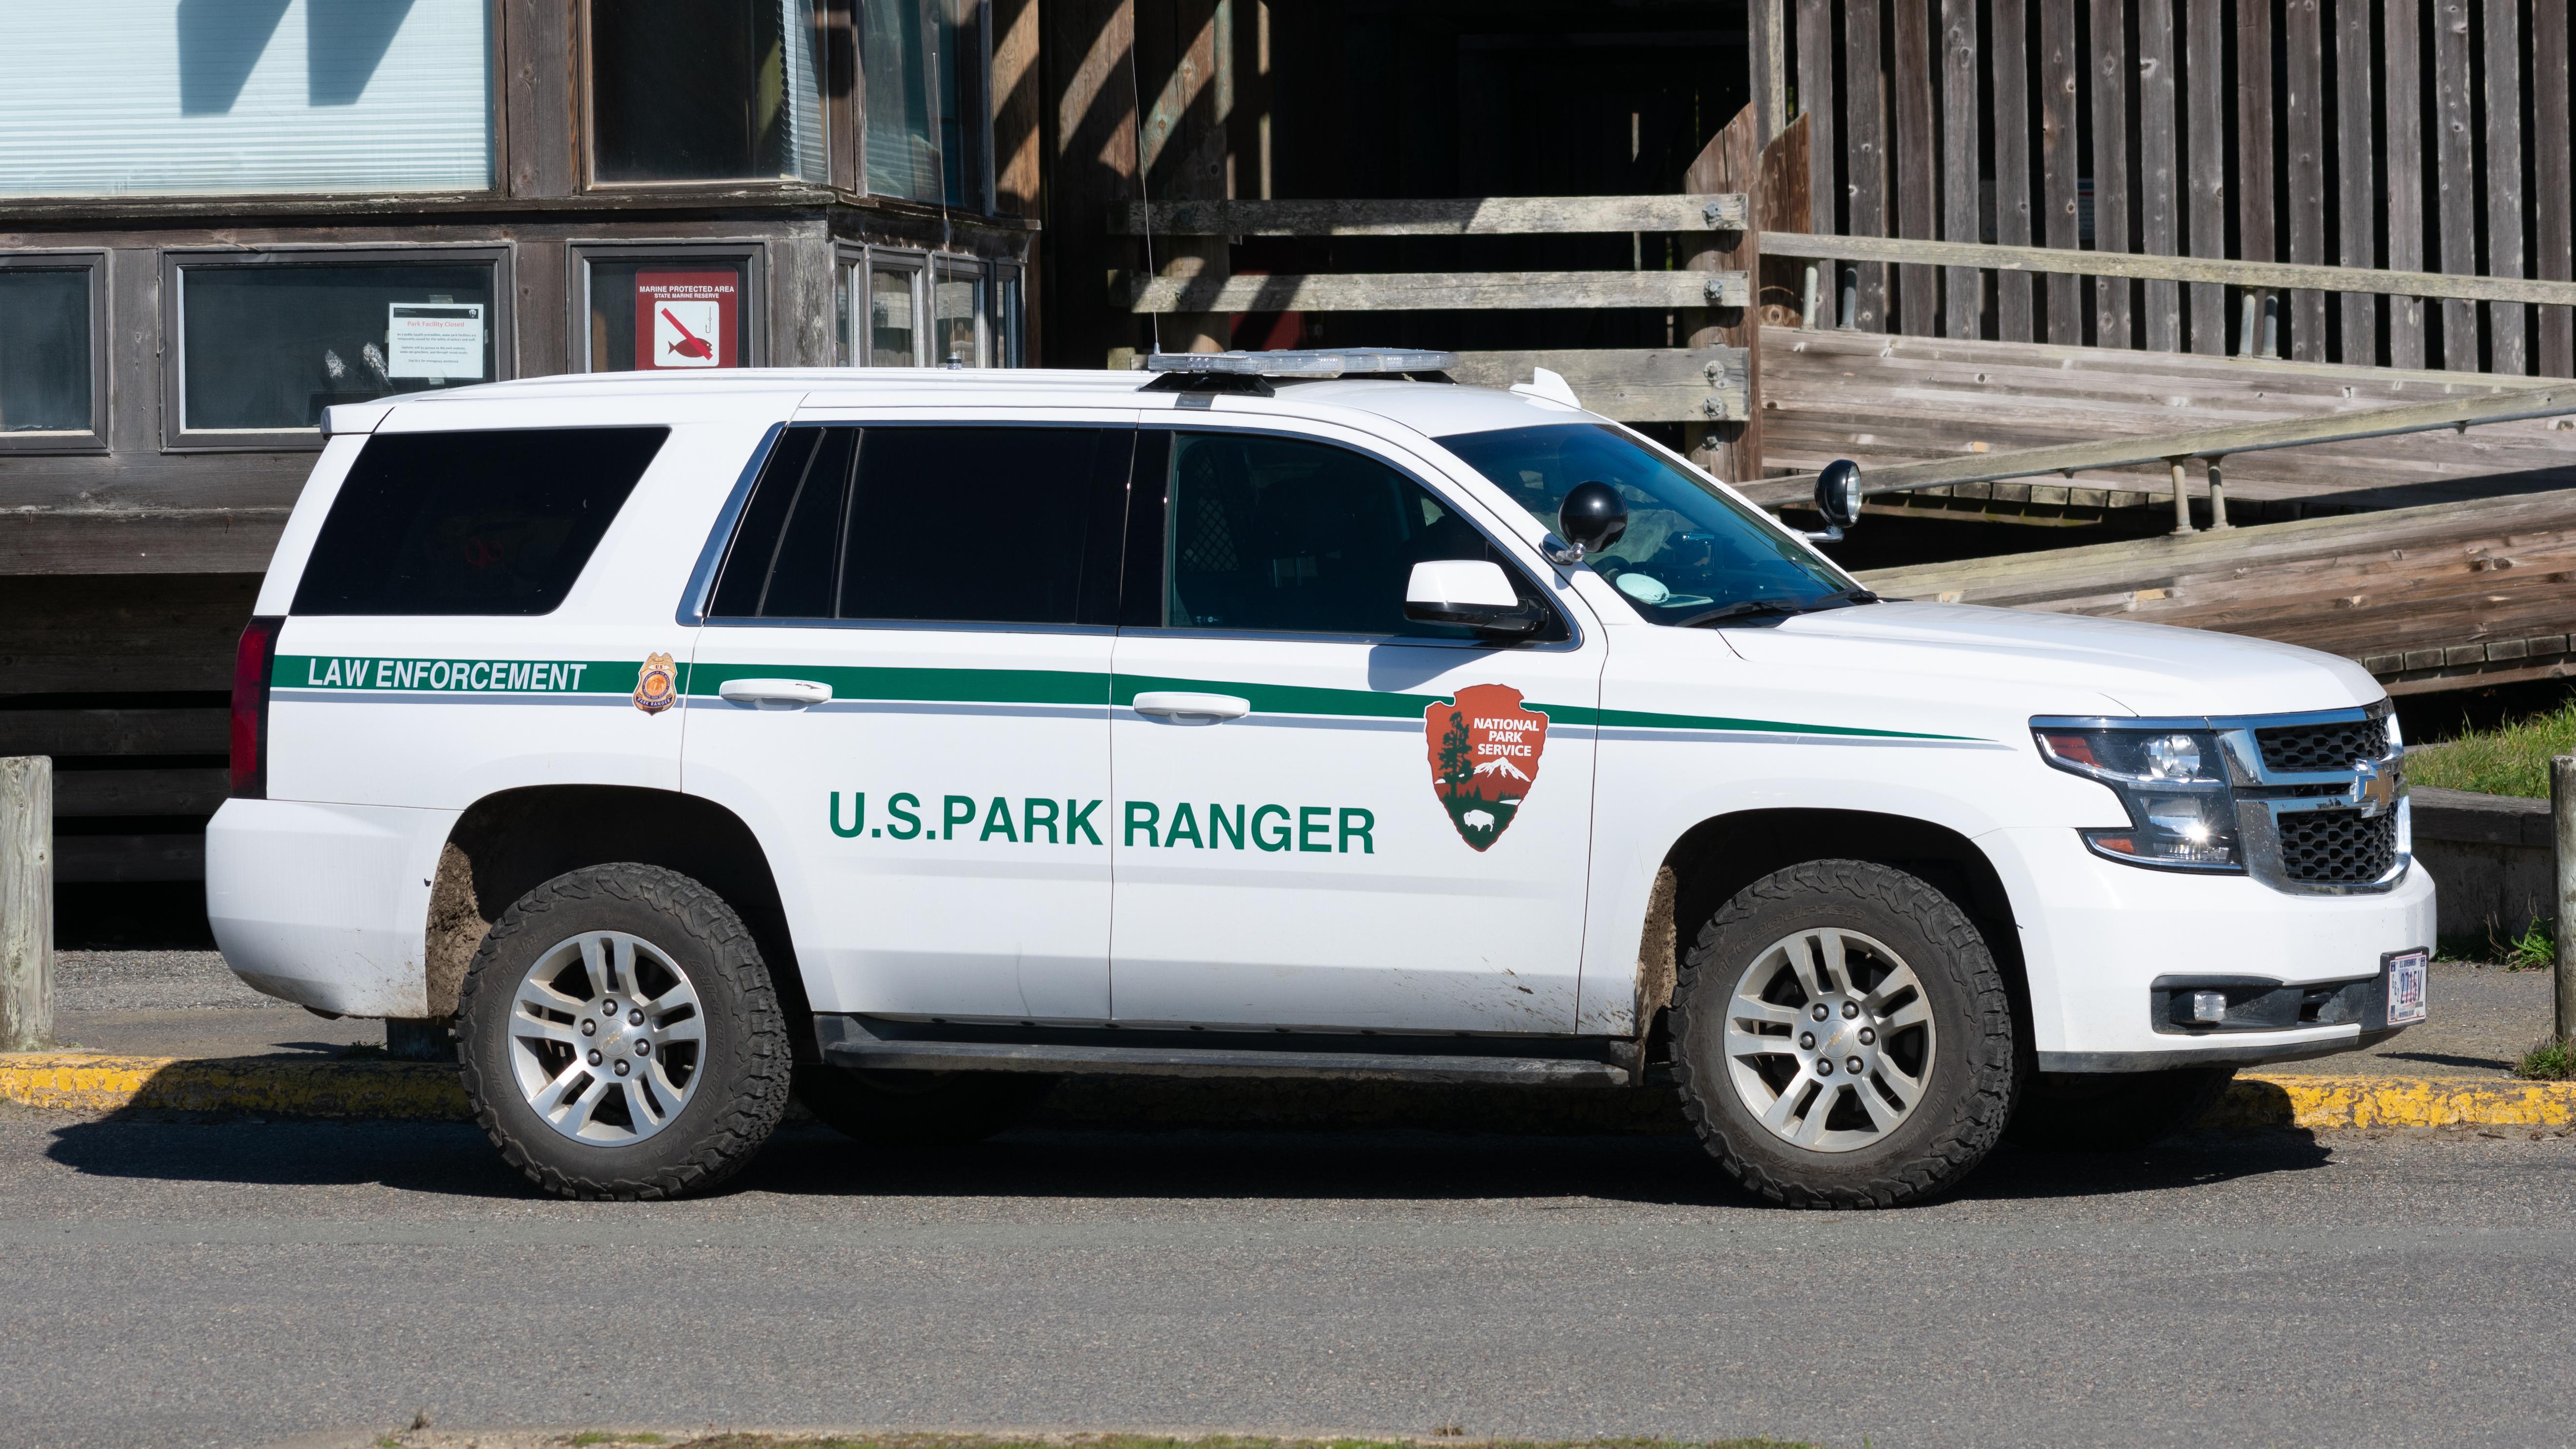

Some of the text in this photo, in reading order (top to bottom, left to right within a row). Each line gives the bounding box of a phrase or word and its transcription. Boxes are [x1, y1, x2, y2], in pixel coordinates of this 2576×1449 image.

[308, 658, 587, 690] LAW ENFORCEMENT
[1474, 718, 1539, 731] NATIONAL
[1489, 731, 1523, 743] PARK
[1478, 744, 1531, 756] SERVICE
[1124, 801, 1375, 854] RANGER
[2400, 969, 2422, 1004] 2715V
